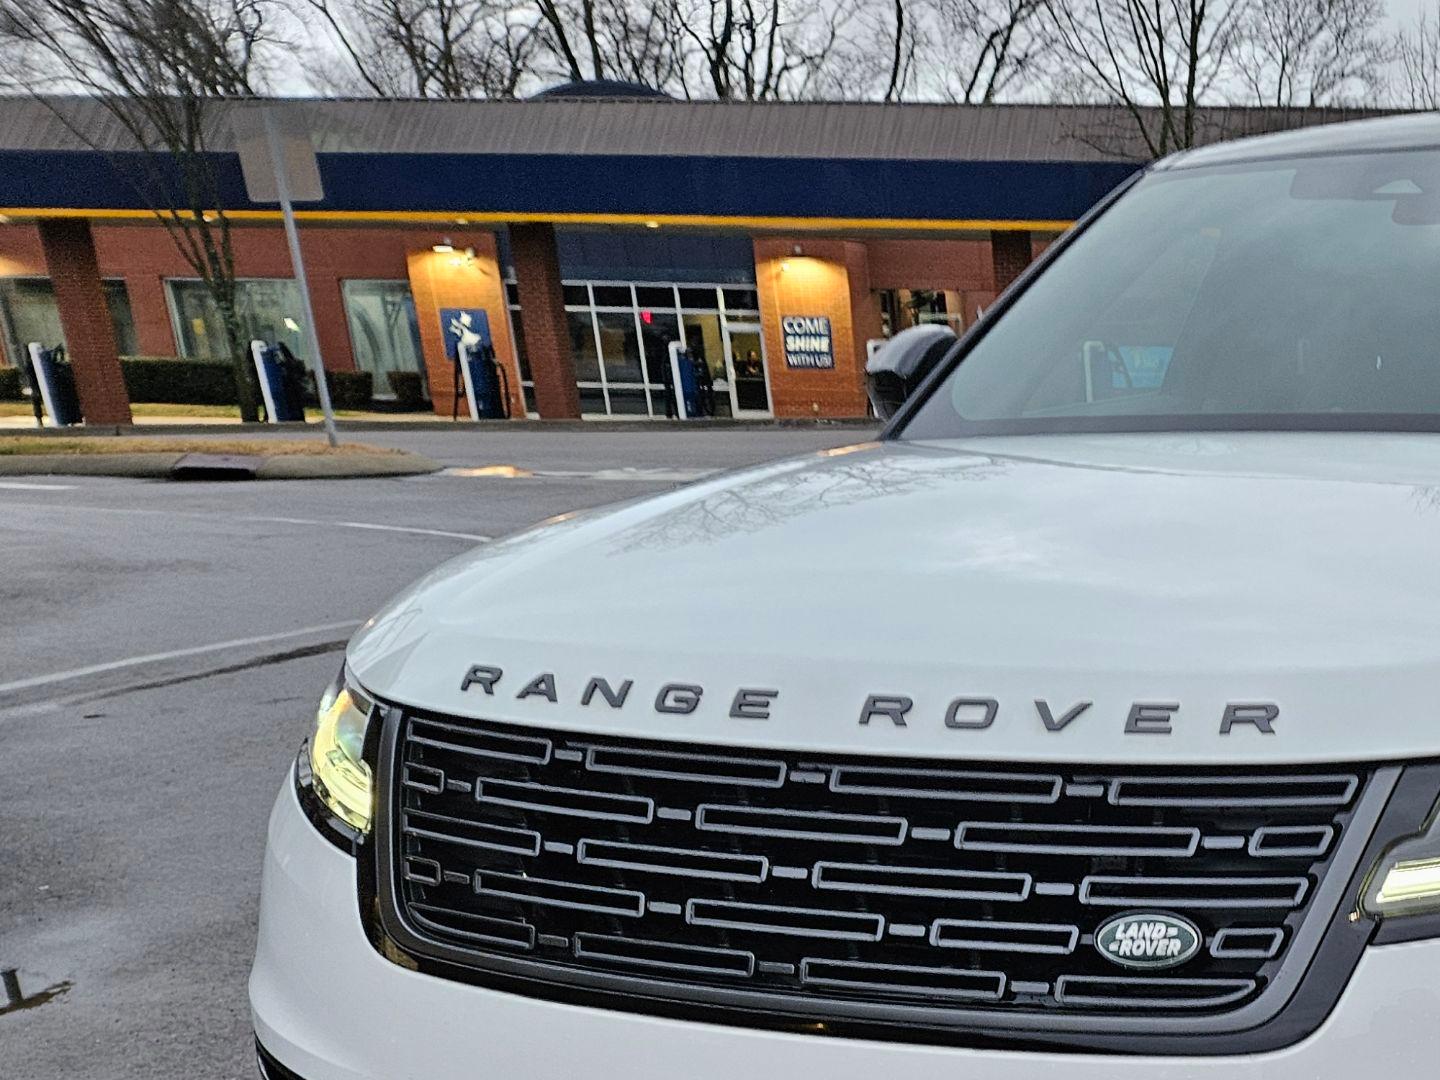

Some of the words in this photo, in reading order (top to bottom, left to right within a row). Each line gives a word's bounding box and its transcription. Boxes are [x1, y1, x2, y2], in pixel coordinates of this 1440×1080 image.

[783, 316, 829, 335] COME
[786, 336, 830, 352] SHINE
[786, 353, 815, 367] WITH
[460, 664, 779, 719] RANGE
[858, 693, 1280, 736] ROVER
[1115, 922, 1167, 940] LAND
[1118, 938, 1182, 956] ROVER
